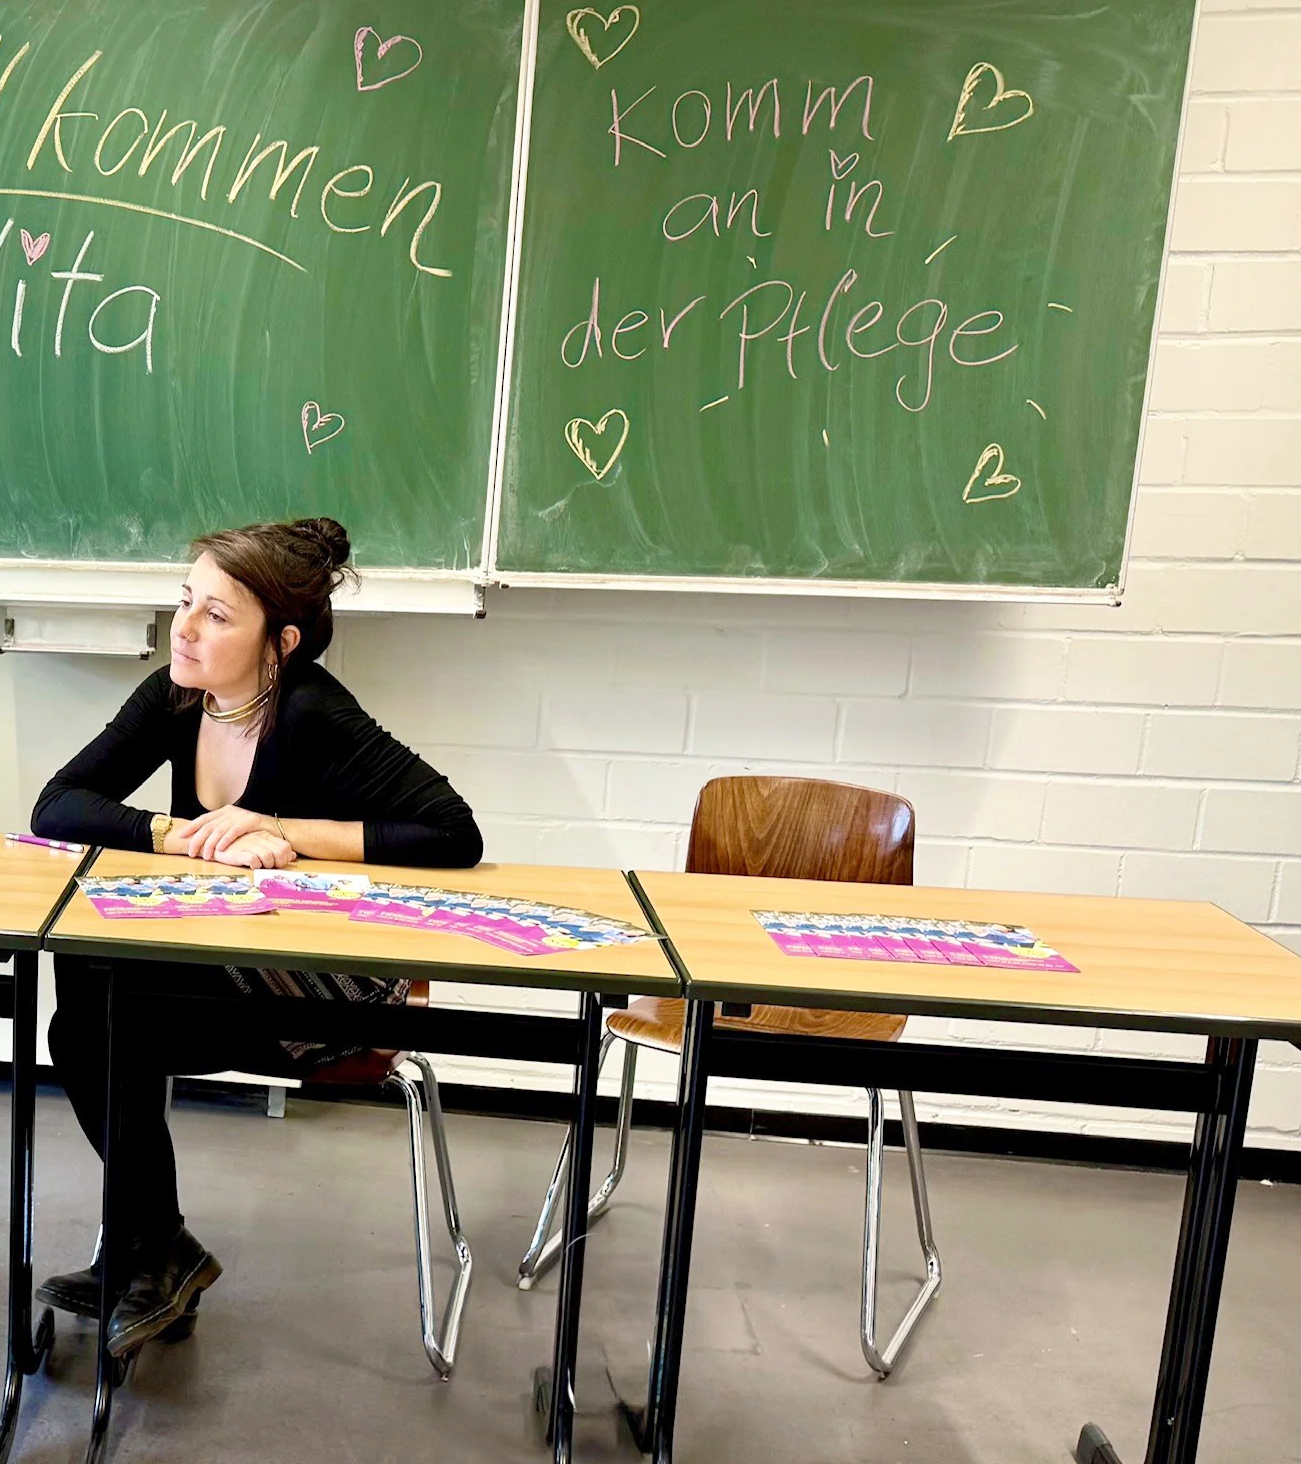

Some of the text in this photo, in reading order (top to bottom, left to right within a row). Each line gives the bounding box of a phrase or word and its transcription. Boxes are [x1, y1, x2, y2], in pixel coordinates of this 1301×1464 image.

[607, 75, 874, 167] Komm
[662, 149, 896, 241] an in
[561, 268, 1020, 412] der Pflege
